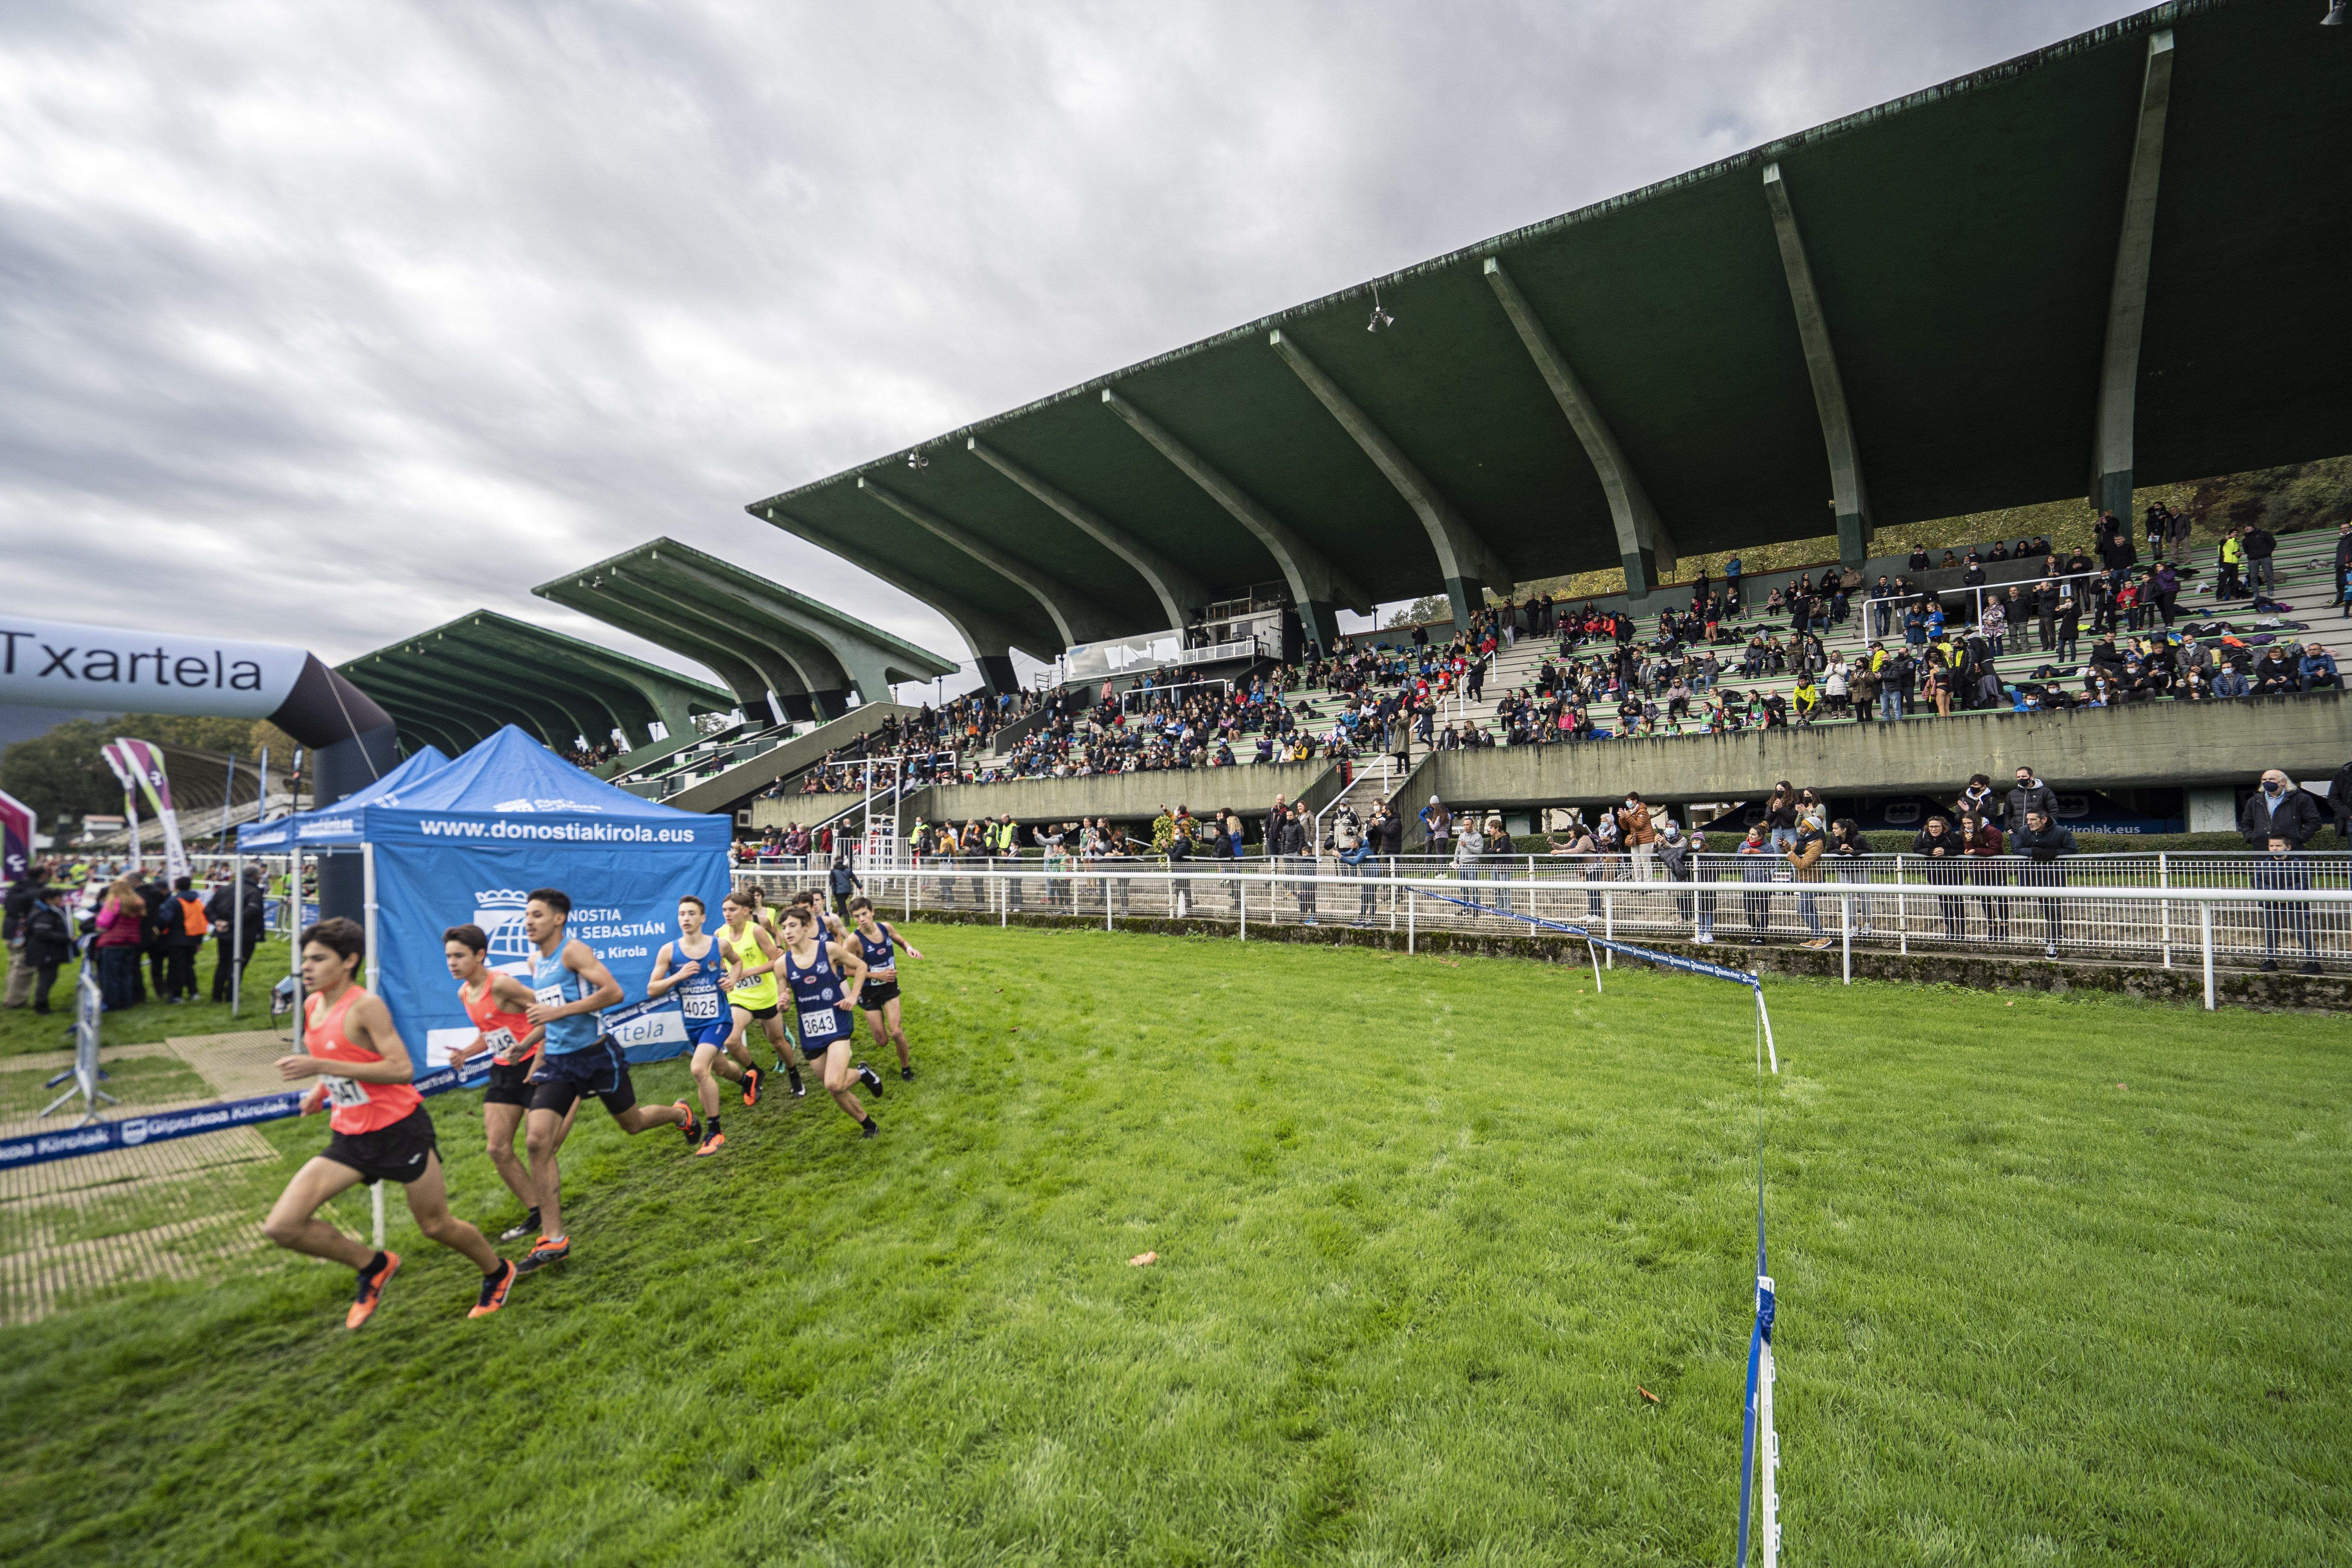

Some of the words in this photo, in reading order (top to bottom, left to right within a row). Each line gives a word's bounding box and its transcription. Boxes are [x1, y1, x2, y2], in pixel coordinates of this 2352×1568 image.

[0, 631, 261, 691] Txartela
[420, 820, 694, 843] www.donostiakirola.eus
[2064, 824, 2141, 834] kirolak.eus
[567, 909, 622, 922] NOSTIA
[581, 921, 666, 939] SEBASTIÁN
[608, 945, 648, 959] Kirola
[684, 1000, 716, 1016] 4025
[612, 1020, 664, 1042] rtela
[804, 1016, 834, 1034] 3643
[148, 1109, 229, 1136] Gipuzkoa
[232, 1098, 289, 1120] Kirolak
[37, 1129, 109, 1155] Kirolak
